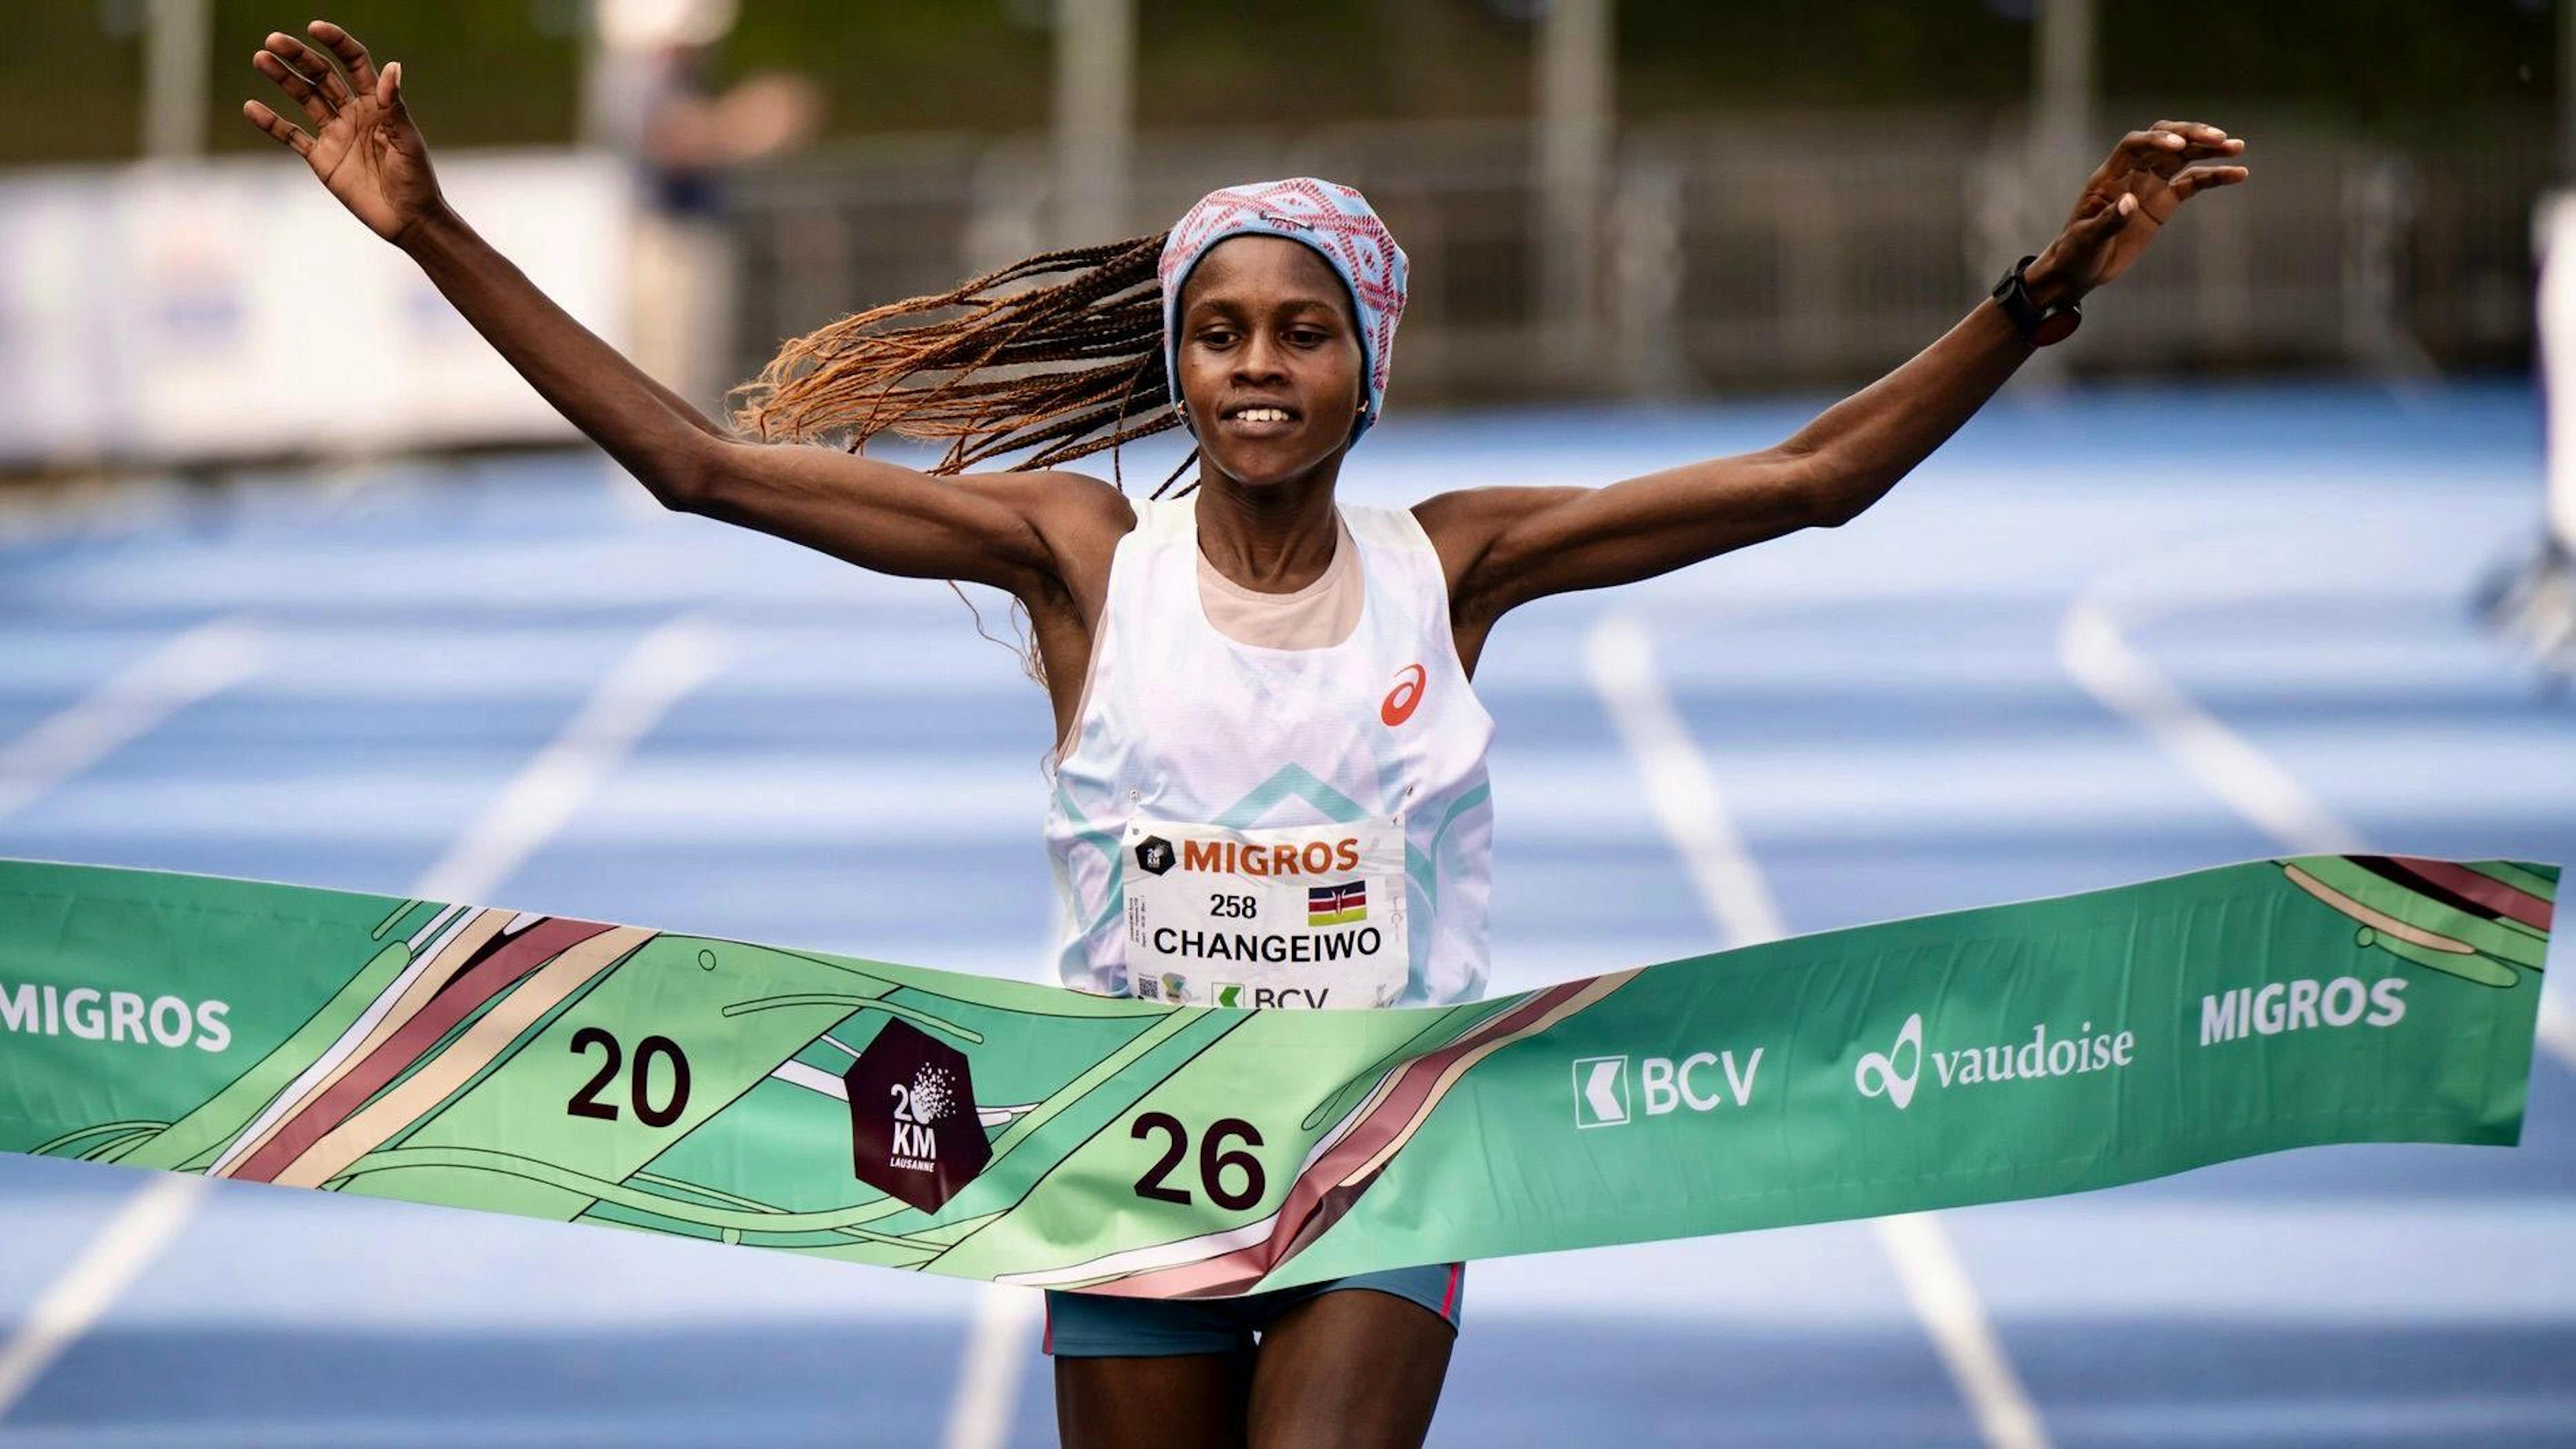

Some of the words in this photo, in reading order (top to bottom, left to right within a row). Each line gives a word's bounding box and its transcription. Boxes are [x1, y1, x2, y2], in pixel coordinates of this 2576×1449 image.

[1184, 839, 1358, 875] MIGROS
[1210, 894, 1256, 918] 258
[1154, 927, 1381, 962] CHANGEIWO
[0, 983, 231, 1052] MIGROS
[2199, 976, 2408, 1046] MIGROS
[567, 1026, 690, 1128] 20
[1642, 1047, 1764, 1115] BCV
[1931, 1022, 2135, 1088] vaudoise
[890, 1062, 956, 1124] 20
[890, 1156, 935, 1173] LAUSANNE
[892, 1121, 936, 1160] KM
[1130, 1112, 1266, 1211] 26
